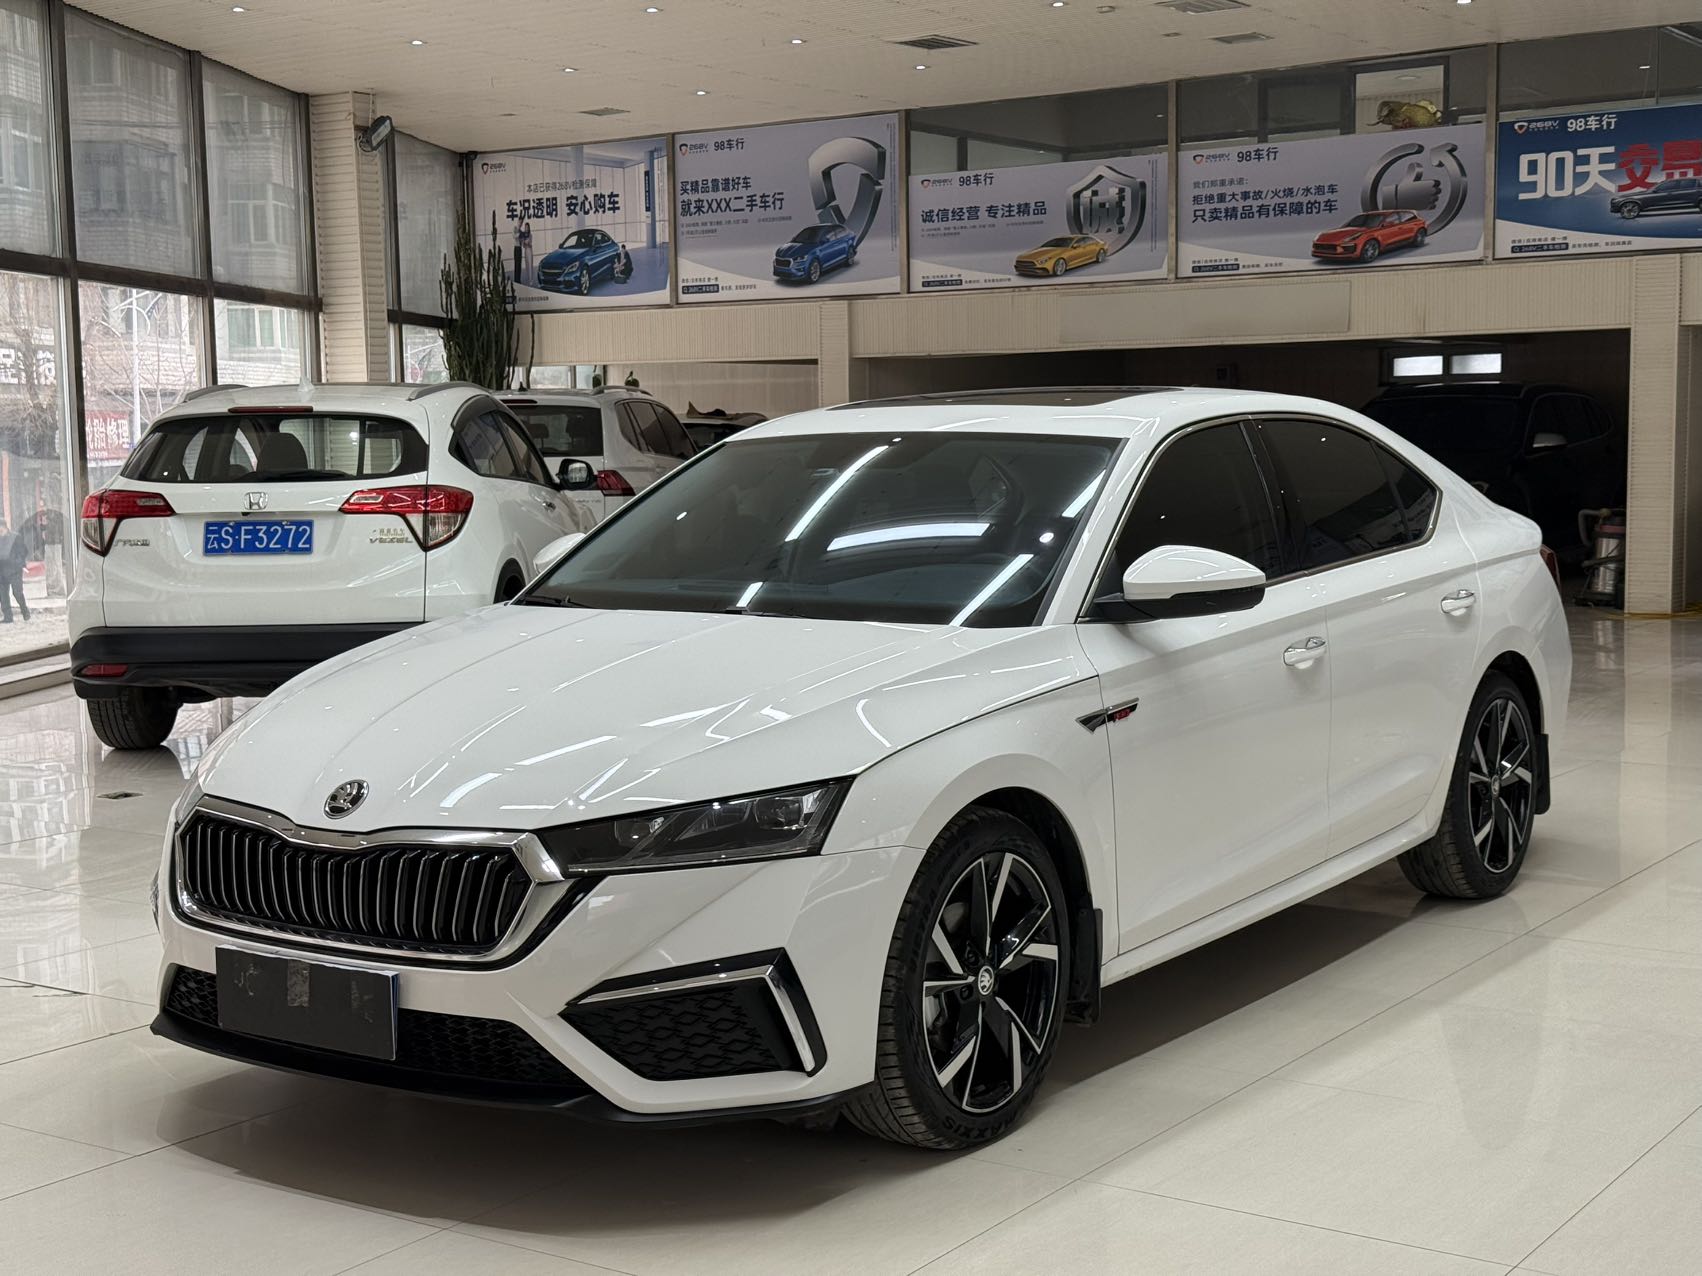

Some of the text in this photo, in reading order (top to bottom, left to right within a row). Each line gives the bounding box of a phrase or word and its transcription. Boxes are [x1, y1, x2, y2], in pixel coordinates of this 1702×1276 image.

[1567, 114, 1617, 132] 98车行
[714, 138, 745, 151] 98车行
[1237, 146, 1278, 163] 98车行
[680, 176, 751, 196] 买精品靠谱好车
[959, 172, 994, 187] 98车行
[680, 192, 784, 217] 就来XXX二手车行
[1192, 184, 1339, 206] 拒绝重大事故/火烧/水泡车
[506, 196, 558, 222] 车况透明
[565, 192, 621, 217] 安心购车
[921, 201, 1047, 224] 诚信经营 专注精品
[1192, 198, 1339, 224] 只卖精品有保障的车
[207, 524, 311, 551] 云S·F3272
